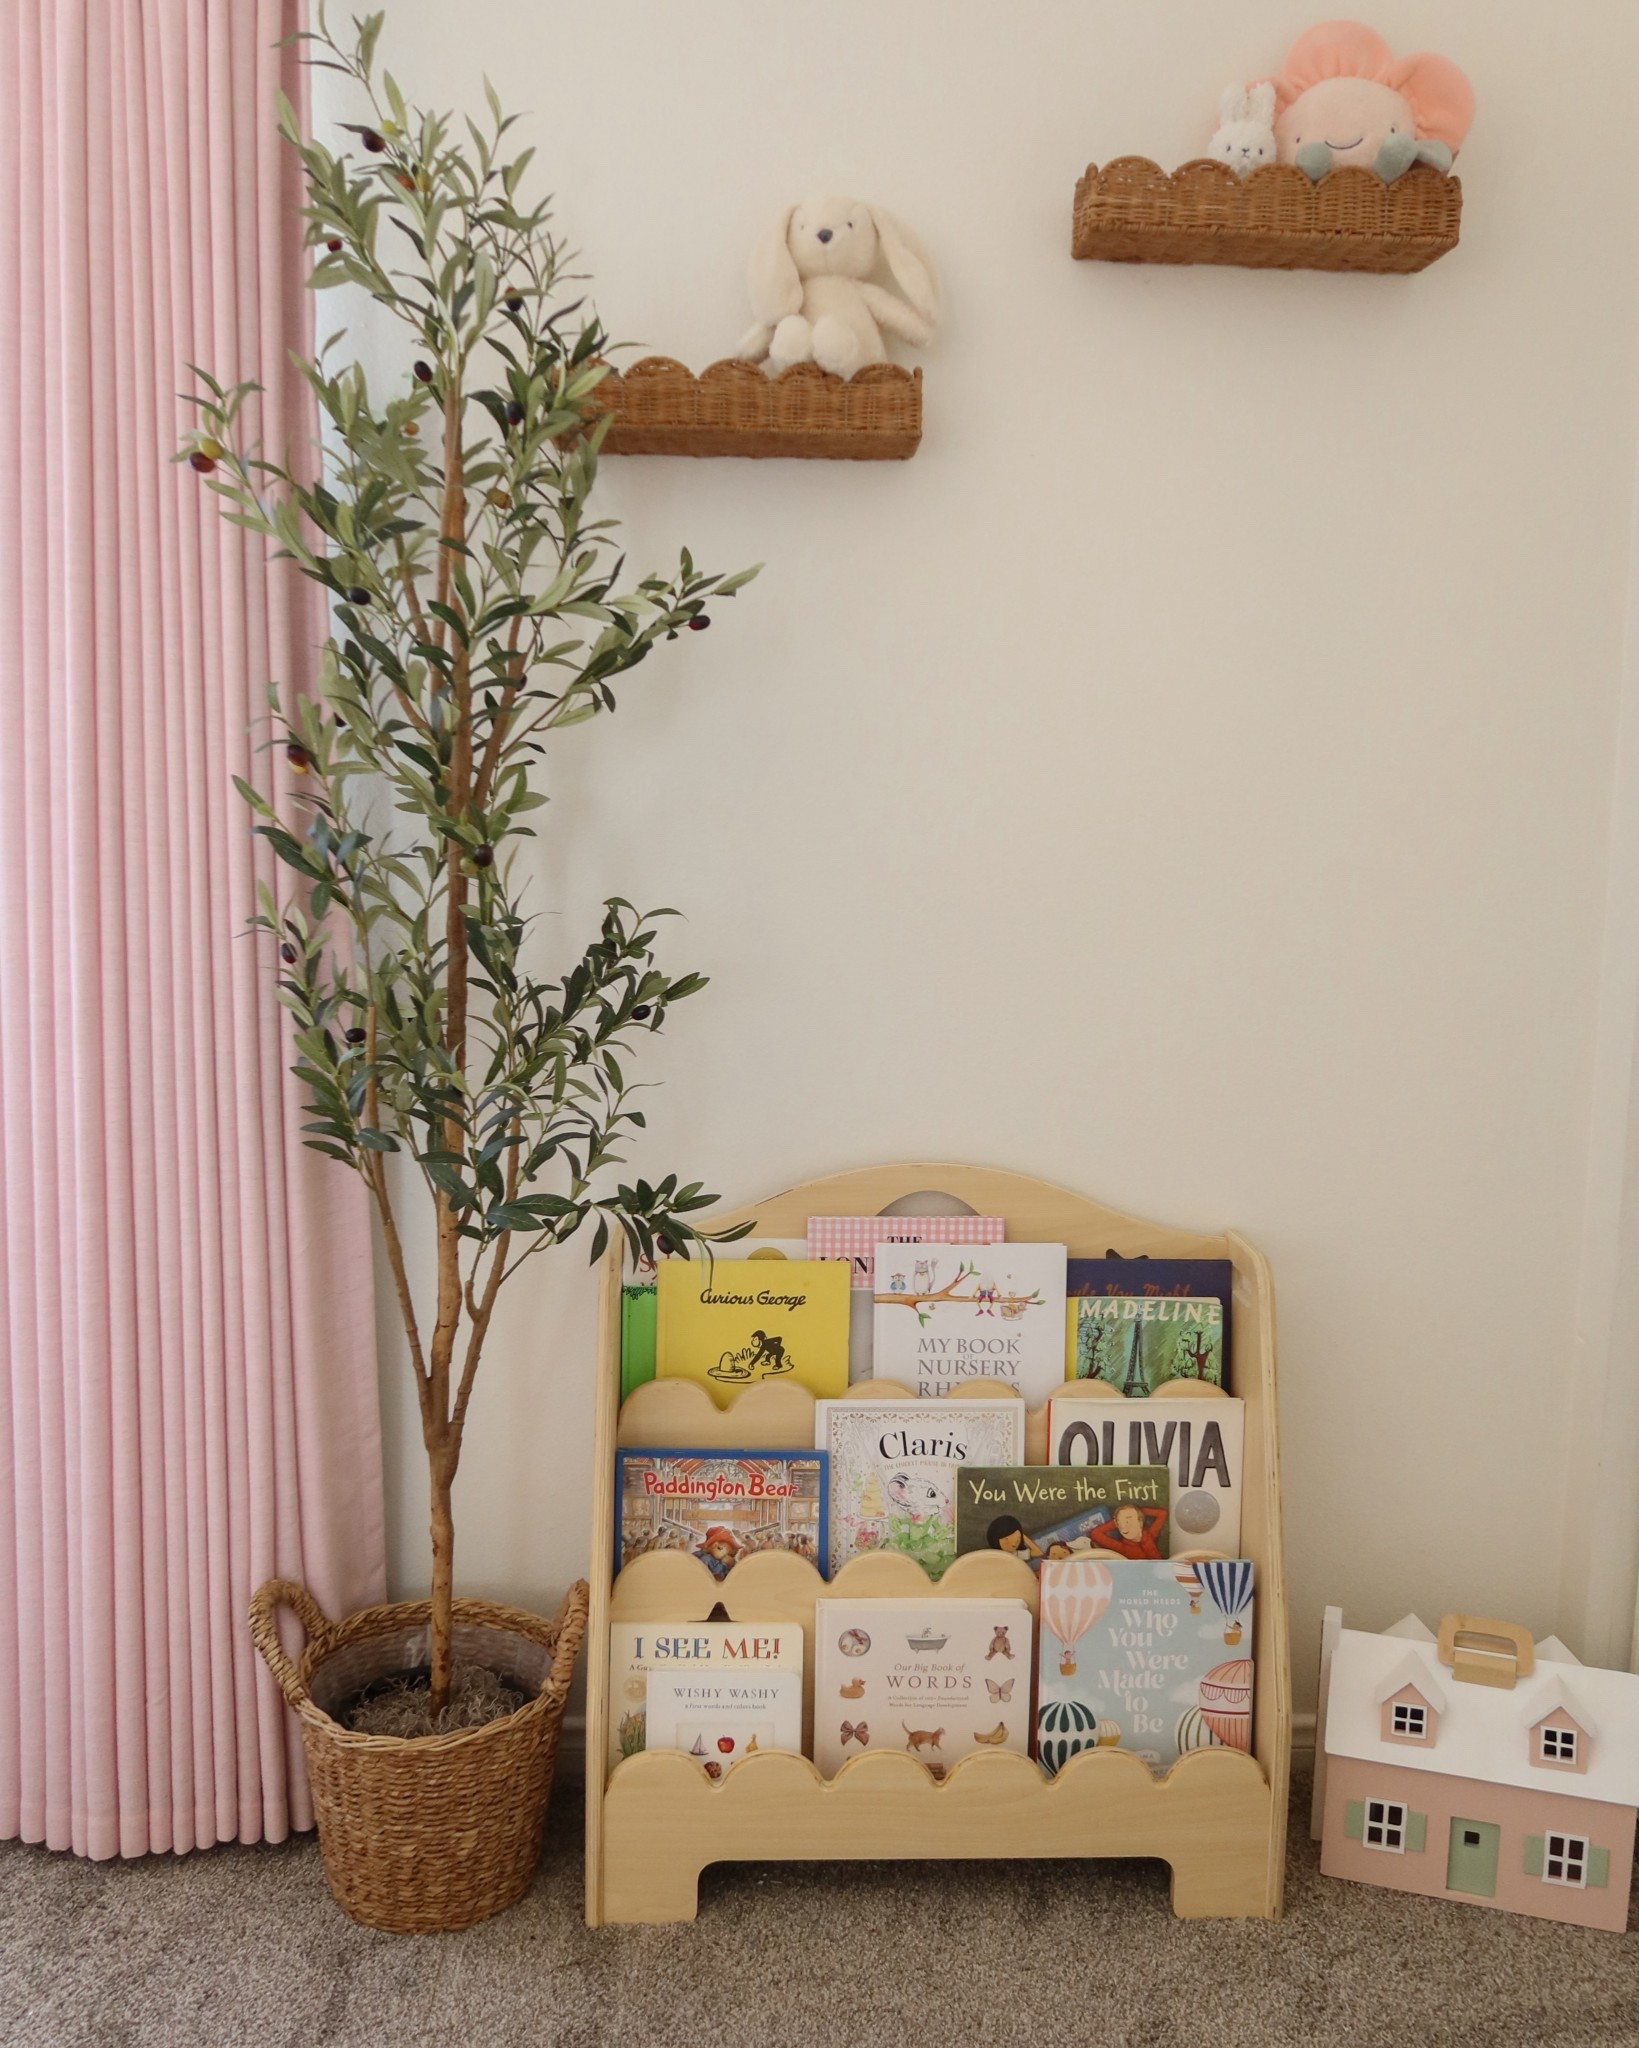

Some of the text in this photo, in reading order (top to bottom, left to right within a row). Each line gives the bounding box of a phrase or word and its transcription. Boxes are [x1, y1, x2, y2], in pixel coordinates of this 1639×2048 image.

[700, 1287, 807, 1312] Curious George
[1080, 1299, 1222, 1326] MADELINE
[917, 1338, 1021, 1355] MY BOOK
[917, 1359, 1022, 1377] NURSERY
[918, 1381, 1022, 1398] RHS
[879, 1430, 968, 1461] Claris
[643, 1472, 798, 1502] Paddington Bear
[968, 1477, 1159, 1505] You Were the First
[1121, 1608, 1178, 1637] Who
[633, 1636, 781, 1660] I SEE ME!
[1108, 1627, 1152, 1648] You
[894, 1663, 966, 1673] Our Big Book of
[1126, 1650, 1188, 1670] Were
[886, 1675, 972, 1689] WORDS
[1098, 1669, 1165, 1696] Made
[673, 1688, 780, 1699] WISHY WASHY
[1123, 1690, 1148, 1712] to
[1133, 1713, 1163, 1733] Be
